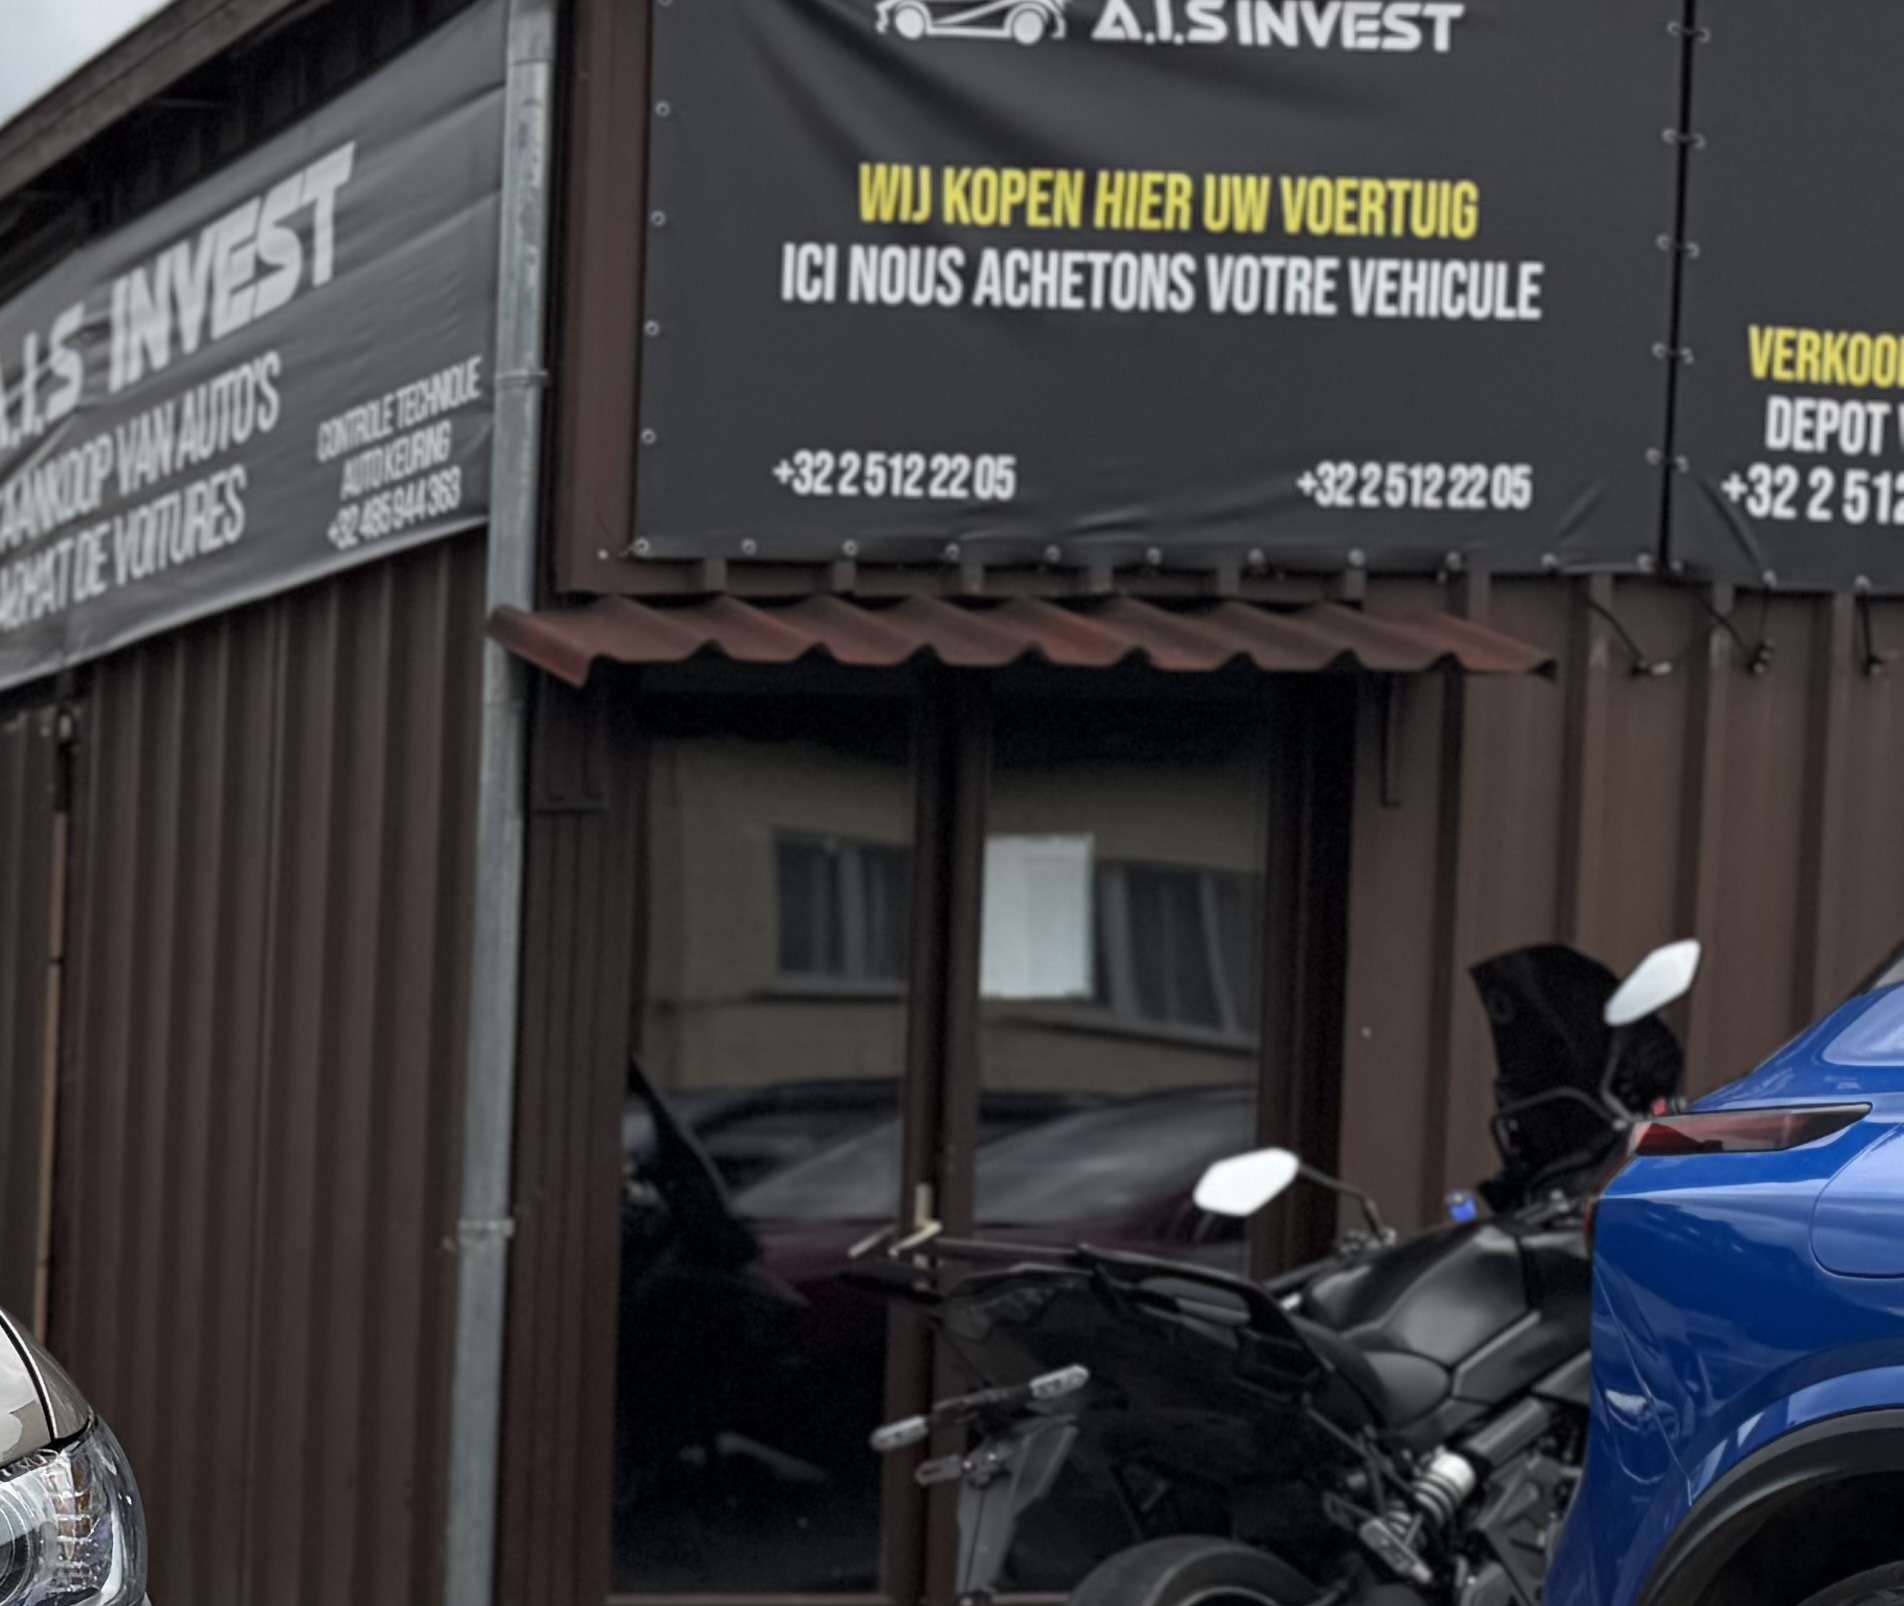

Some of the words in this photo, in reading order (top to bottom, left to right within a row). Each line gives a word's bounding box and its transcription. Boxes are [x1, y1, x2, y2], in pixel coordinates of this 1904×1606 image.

[1091, 0, 1228, 44] A.I.S
[1237, 2, 1465, 53] INVEST
[858, 162, 932, 223] WIJ
[942, 165, 1084, 229] KOPEN
[1093, 170, 1192, 231] HIER
[1203, 173, 1271, 234] UW
[1280, 175, 1479, 240] VOERTUIG
[109, 141, 355, 394] INVEST
[781, 242, 837, 302] ICI
[847, 243, 966, 307] NOUS
[971, 247, 1196, 313] ACHETONS
[1206, 253, 1340, 316] VOTRE
[1348, 257, 1544, 320] VEHICULE
[1748, 324, 1904, 389] VERKOO
[1765, 394, 1891, 456] DEPOT
[1720, 462, 1799, 520] +32
[1805, 465, 1835, 521] 2
